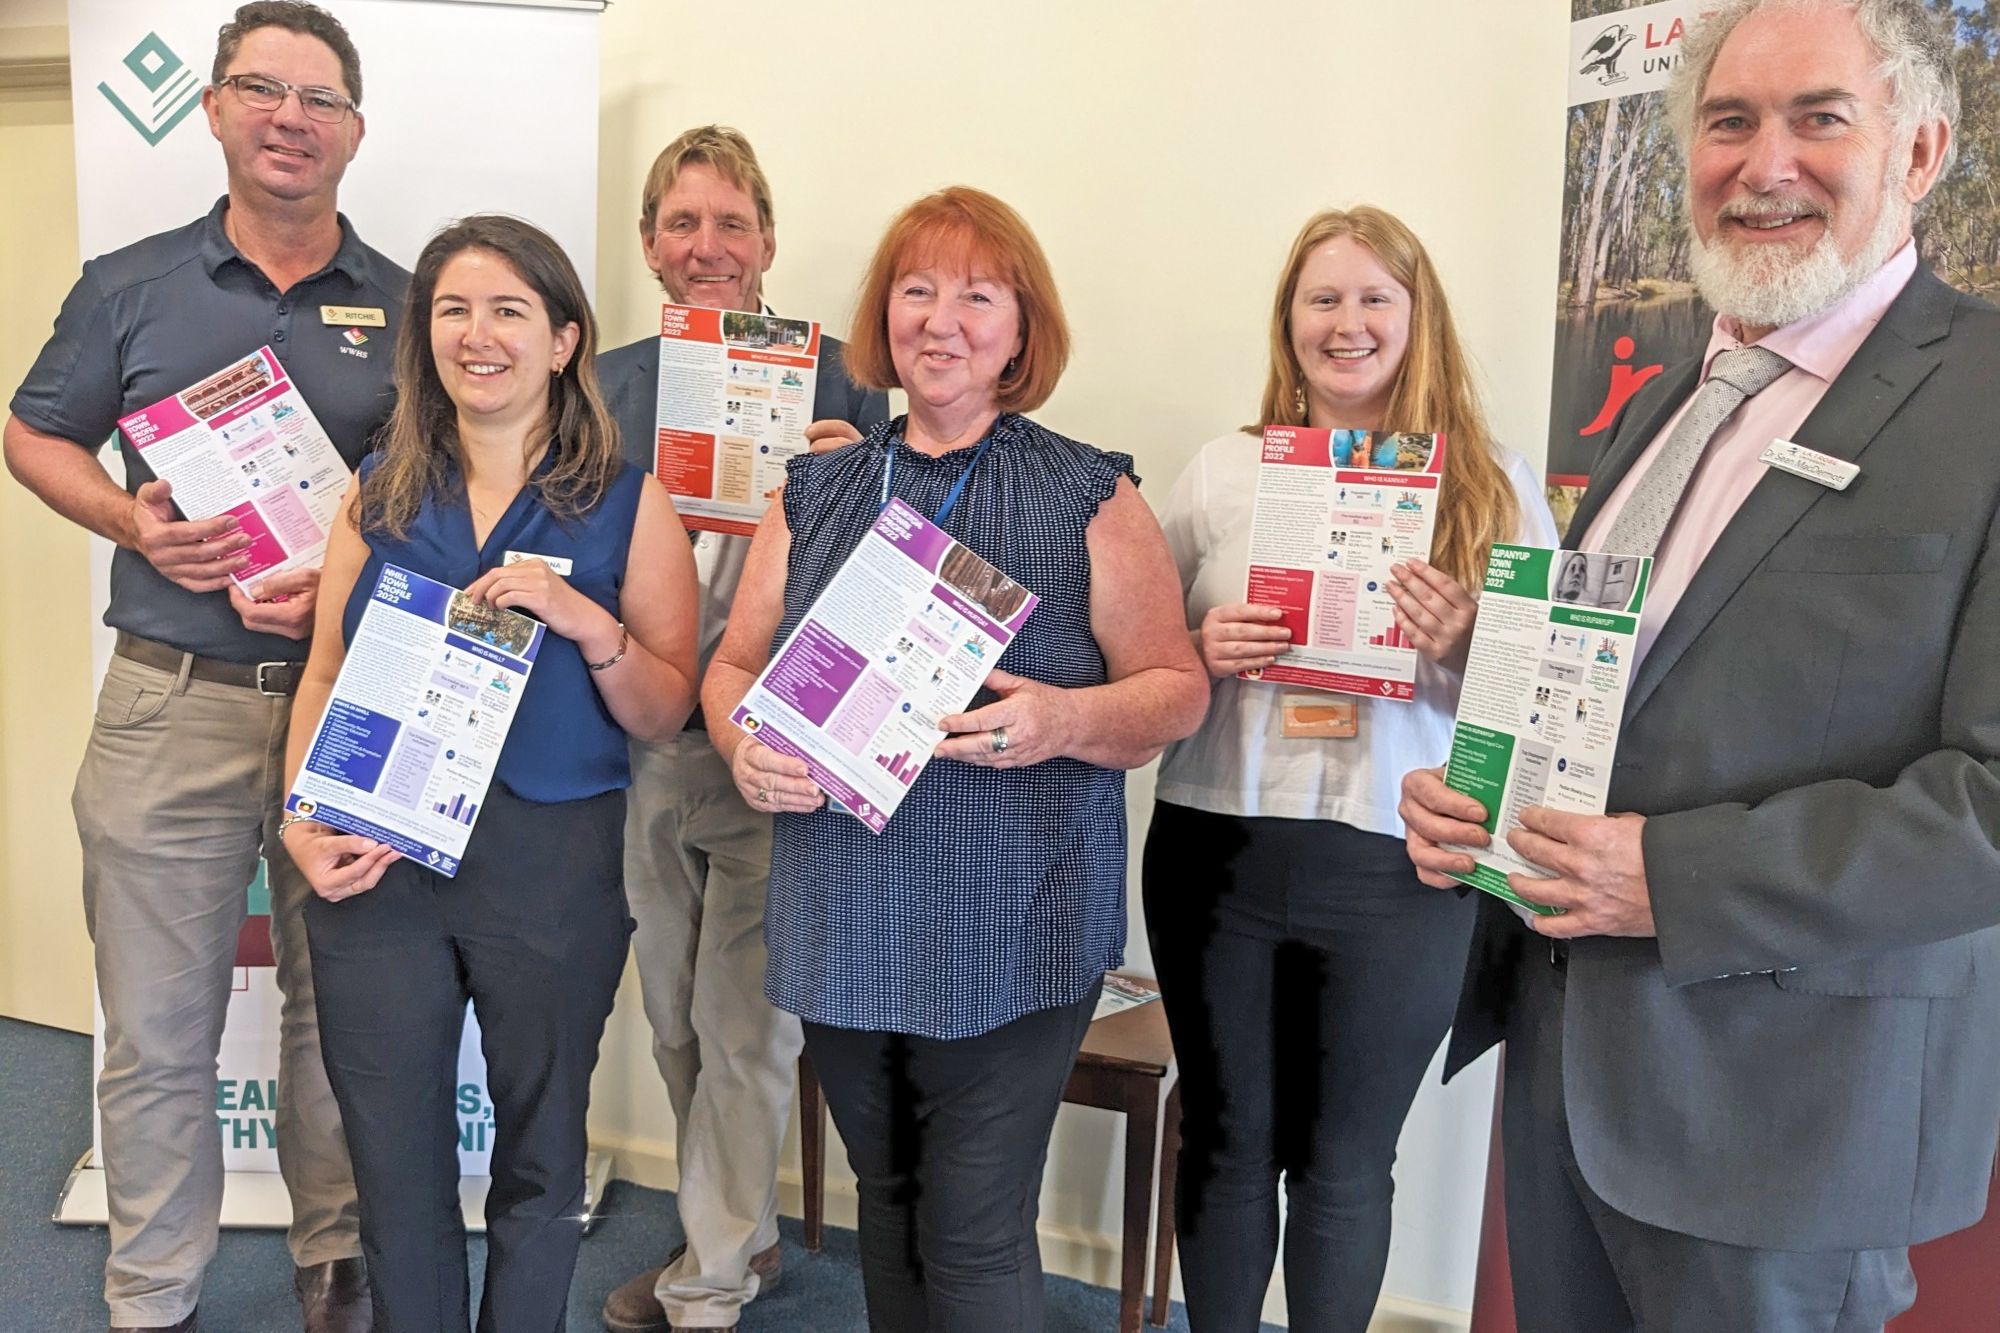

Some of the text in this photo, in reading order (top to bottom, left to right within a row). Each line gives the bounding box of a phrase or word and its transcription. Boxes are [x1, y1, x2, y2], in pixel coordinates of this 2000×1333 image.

[345, 312, 376, 321] RITCHIE
[664, 307, 690, 317] JEPARIT
[664, 314, 685, 323] TOWN
[663, 320, 689, 330] PROFILE
[663, 327, 681, 336] 2022
[339, 346, 369, 359] WWHS
[121, 411, 149, 429] MINYIP
[127, 419, 151, 435] TOWN
[130, 423, 160, 441] PROFILE
[135, 432, 157, 446] 2022
[1266, 429, 1297, 439] KANIVA
[1265, 436, 1289, 446] TOWN
[1263, 444, 1295, 454] PROFILE
[1263, 452, 1285, 461] 2022
[1491, 548, 1531, 561] RUPANYUP
[1489, 558, 1513, 569] TOWN
[383, 567, 409, 583] NHILL
[1487, 567, 1516, 580] PROFILE
[380, 574, 409, 591] TOWN
[1485, 577, 1505, 588] 2022
[375, 588, 400, 604] 2022
[378, 581, 412, 601] PROFILE
